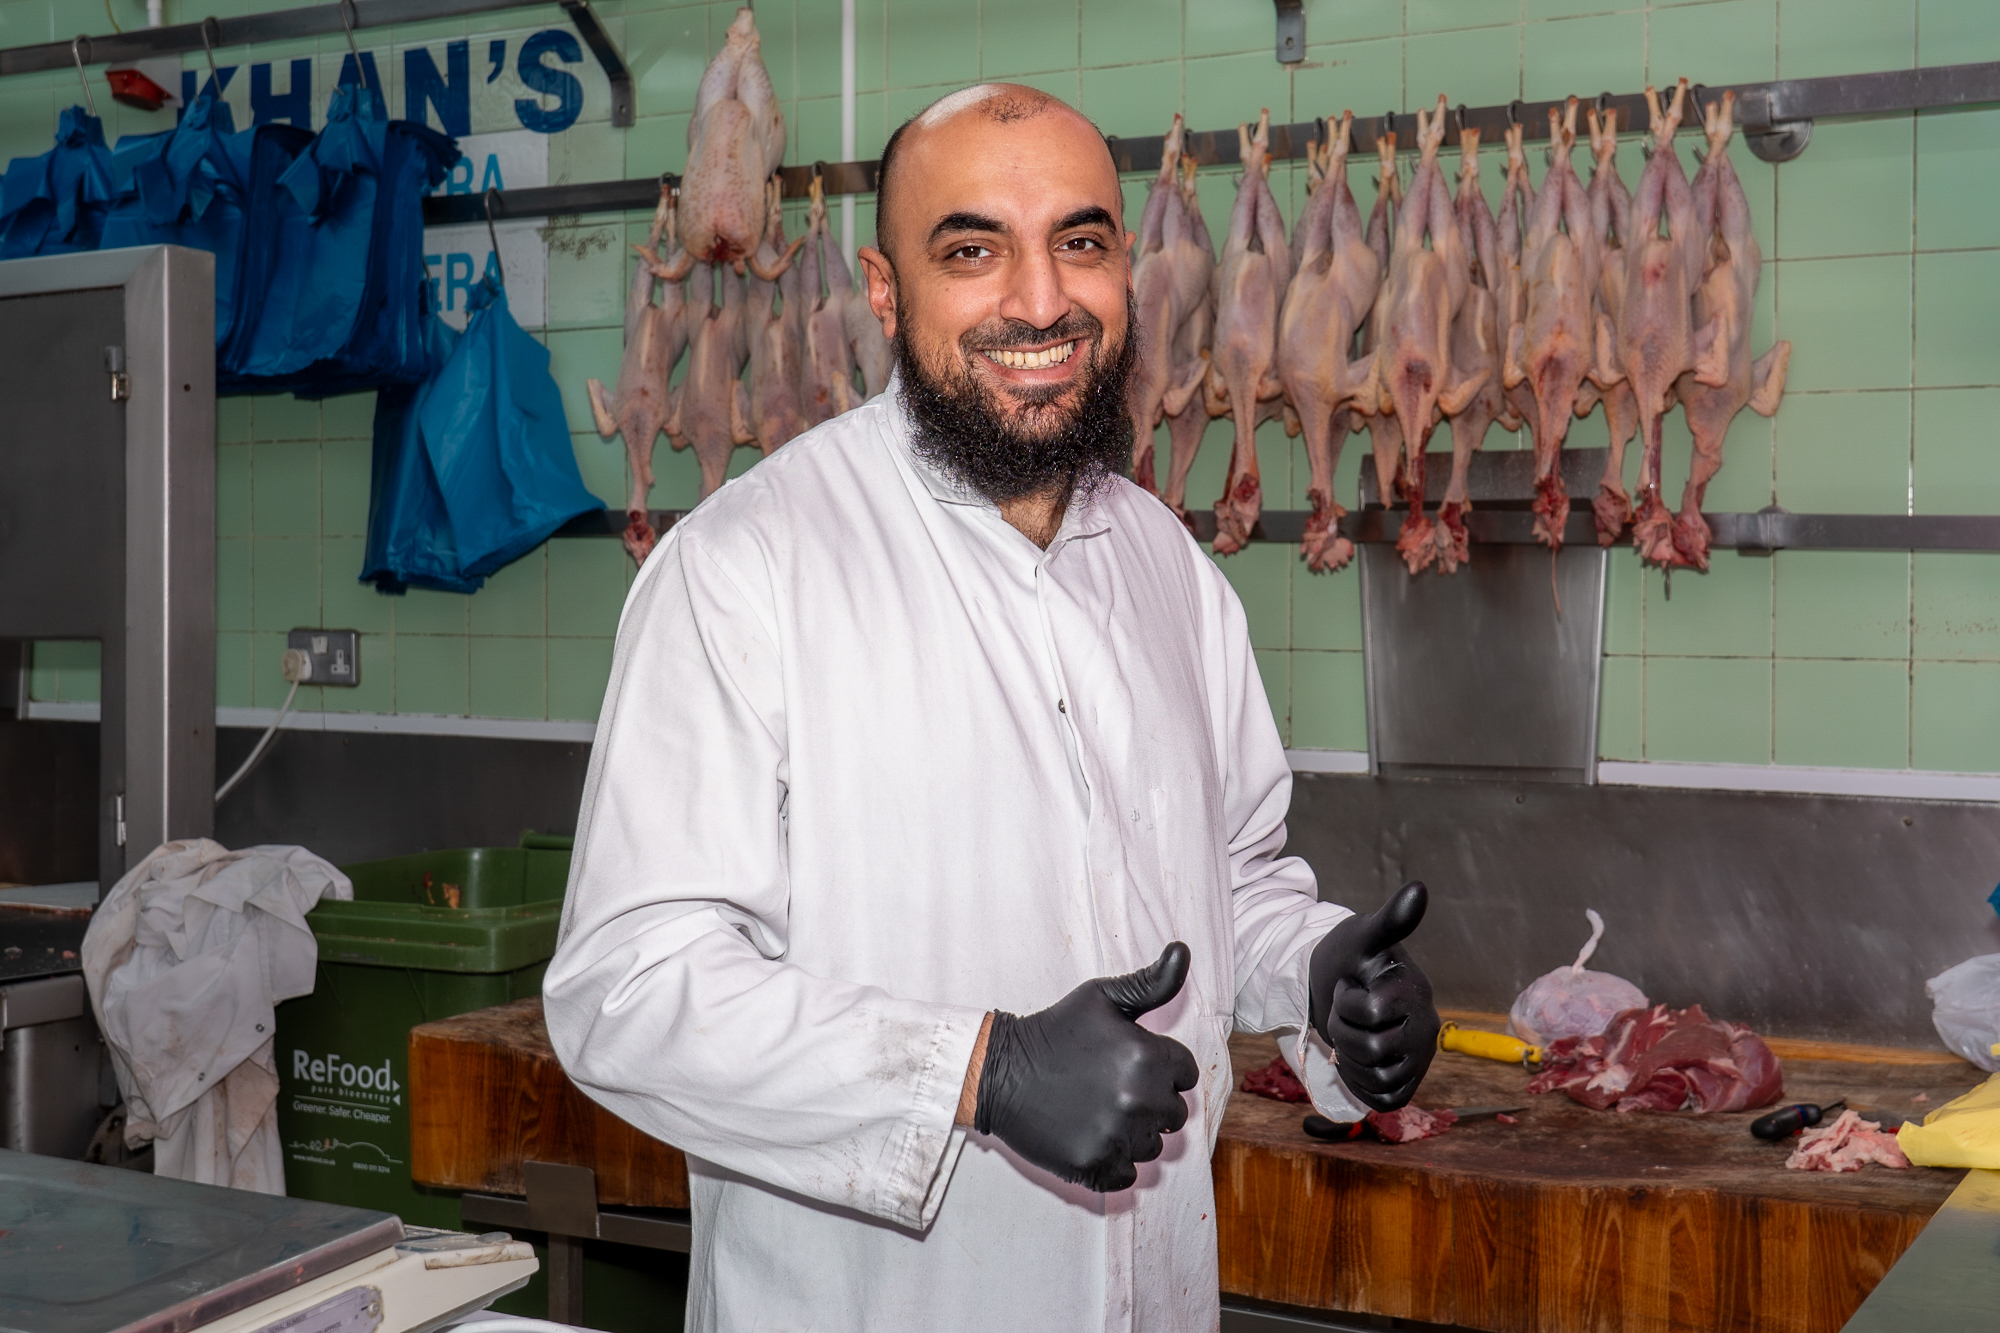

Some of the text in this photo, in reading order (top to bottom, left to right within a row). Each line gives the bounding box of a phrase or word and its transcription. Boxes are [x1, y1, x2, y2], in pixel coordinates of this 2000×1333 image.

[176, 29, 584, 137] KHAN'S
[293, 1049, 391, 1091] ReFood
[311, 1085, 391, 1103] pure bioenergy
[293, 1100, 391, 1123] Greener. Safer. Cheaper.
